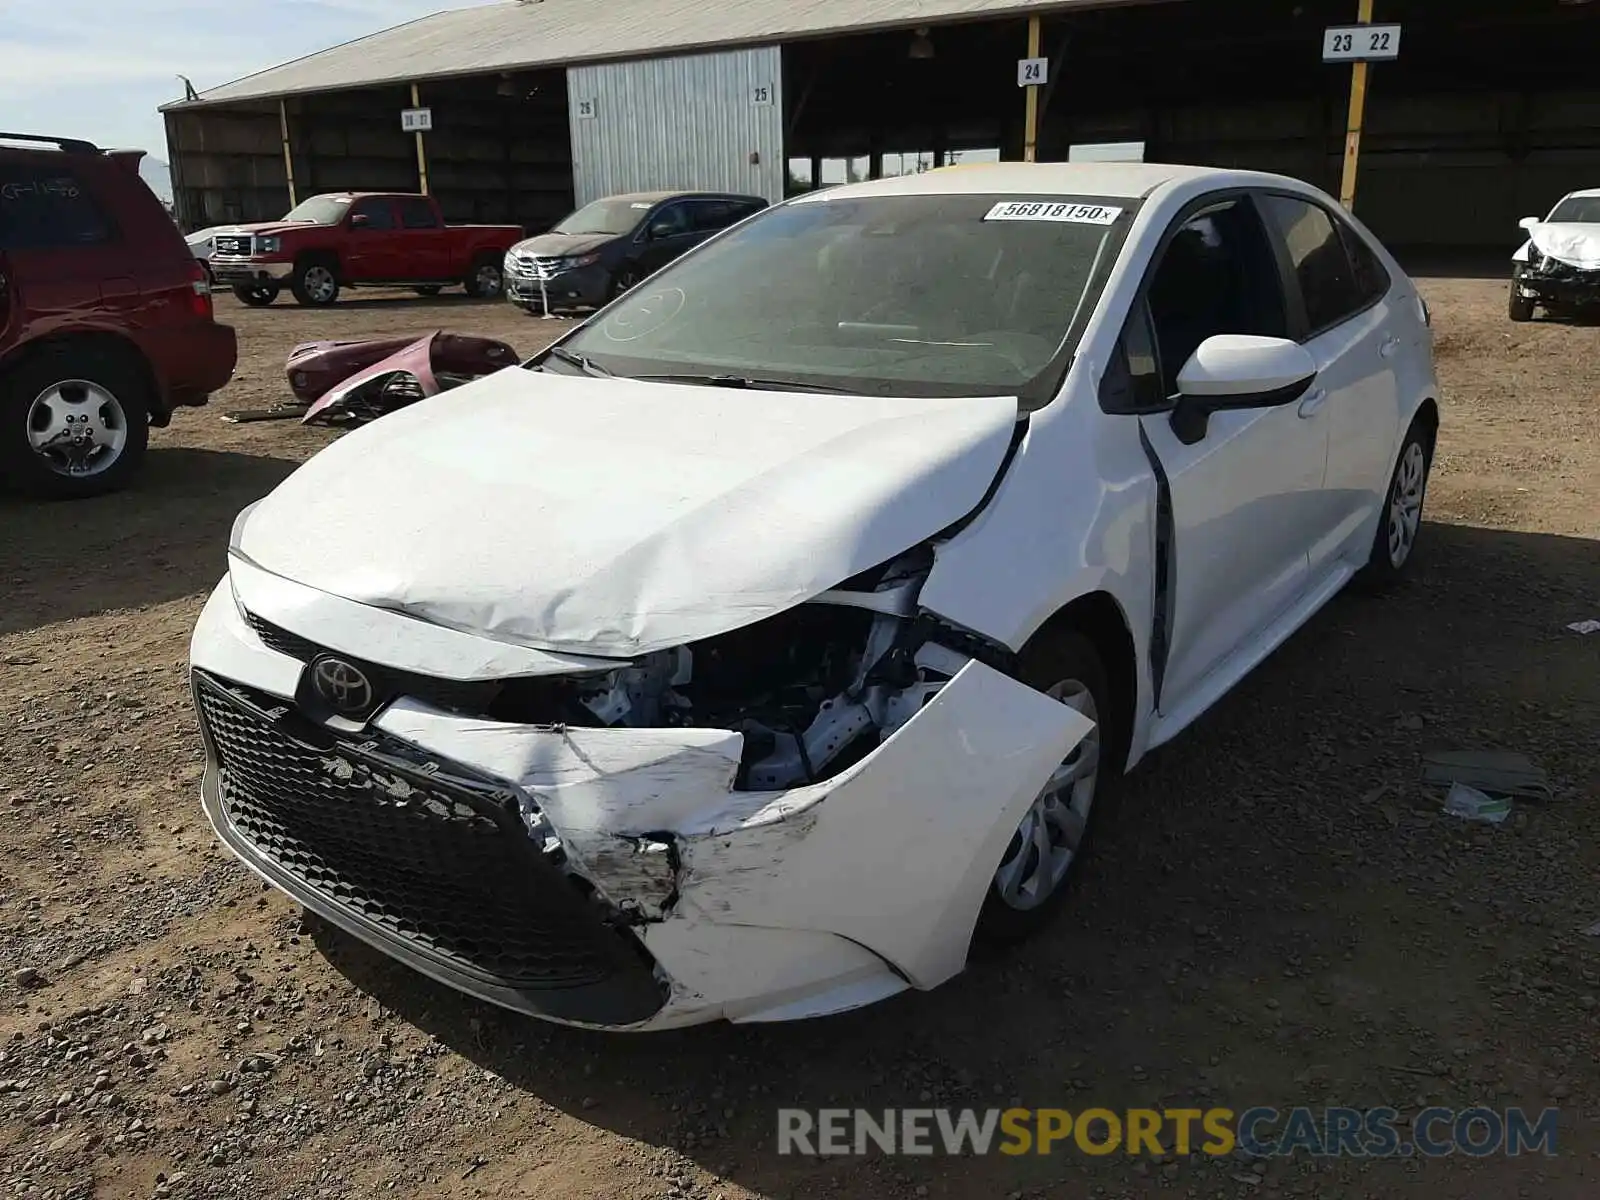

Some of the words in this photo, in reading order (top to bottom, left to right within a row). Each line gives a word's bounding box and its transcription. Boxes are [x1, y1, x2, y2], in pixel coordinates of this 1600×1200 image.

[1332, 34, 1353, 52] 23
[1369, 32, 1390, 51] 22
[1025, 63, 1040, 80] 24
[754, 87, 767, 102] 25
